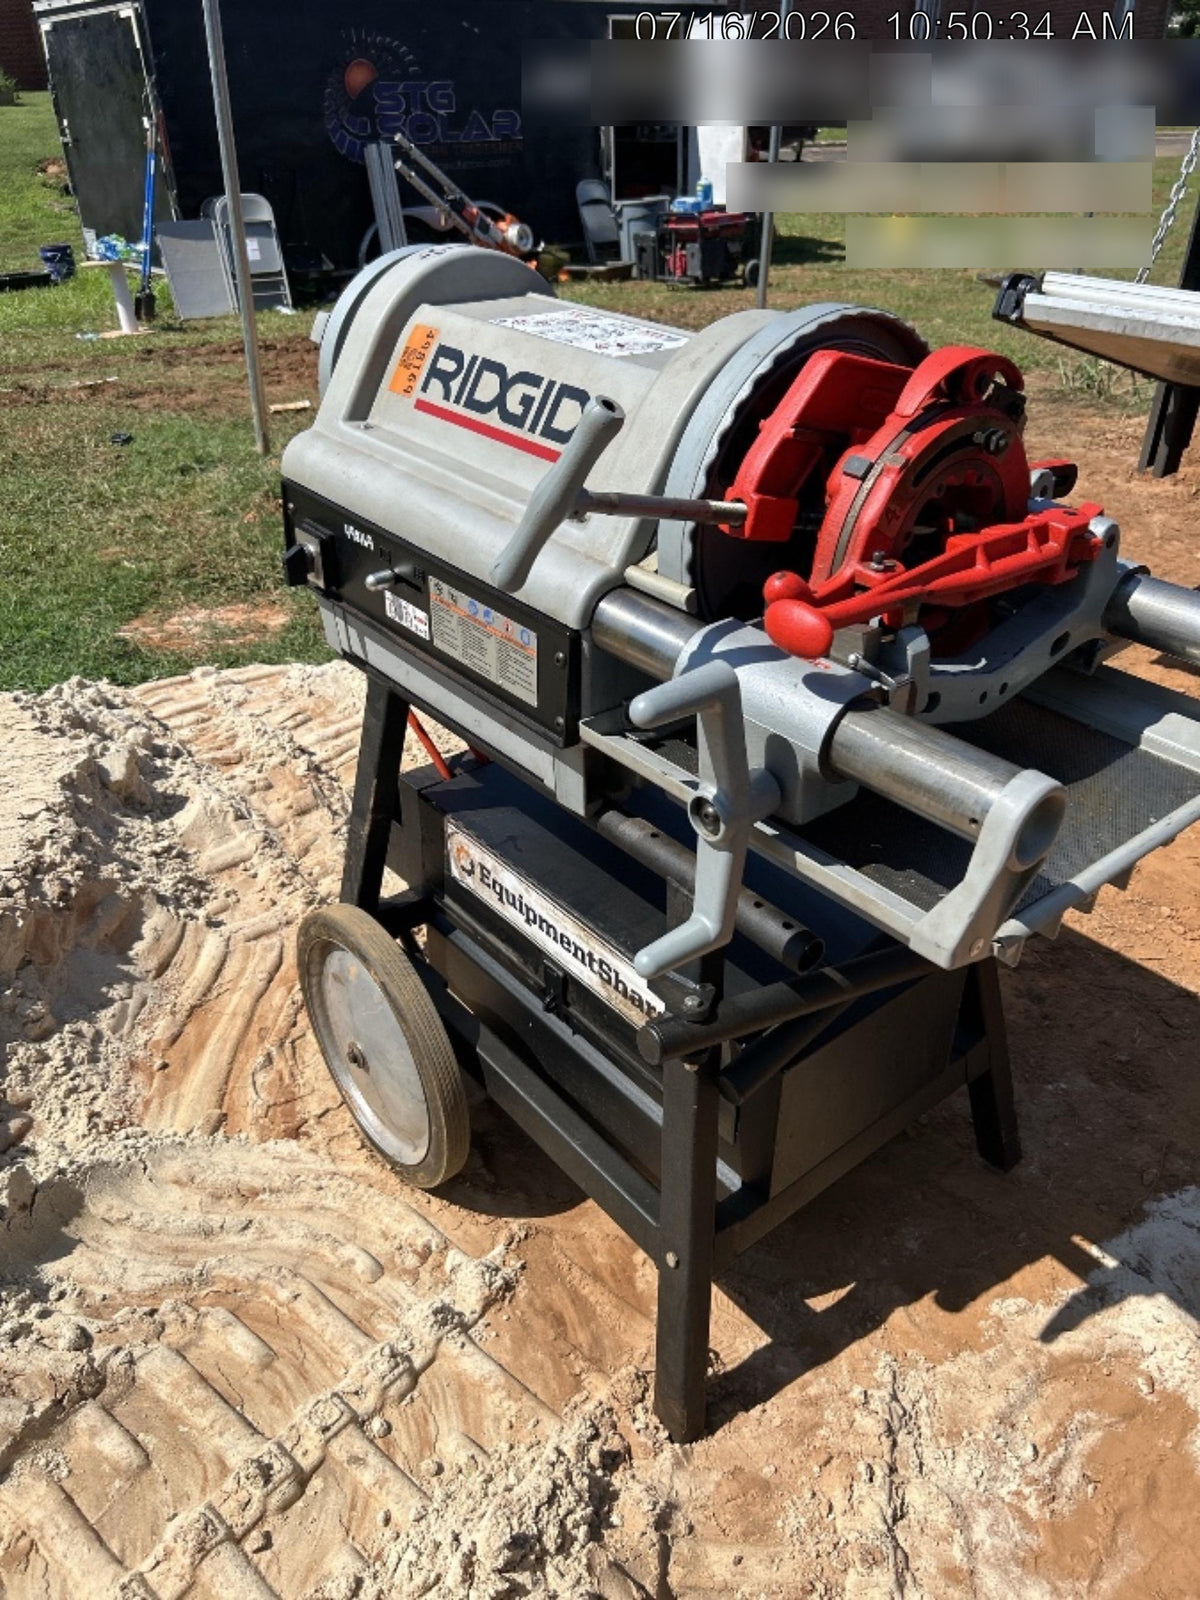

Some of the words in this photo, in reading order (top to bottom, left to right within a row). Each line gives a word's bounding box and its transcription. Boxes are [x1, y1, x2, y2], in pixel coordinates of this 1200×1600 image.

[373, 81, 456, 115] STG
[376, 110, 523, 144] SOLAR
[421, 343, 591, 445] RIDGID
